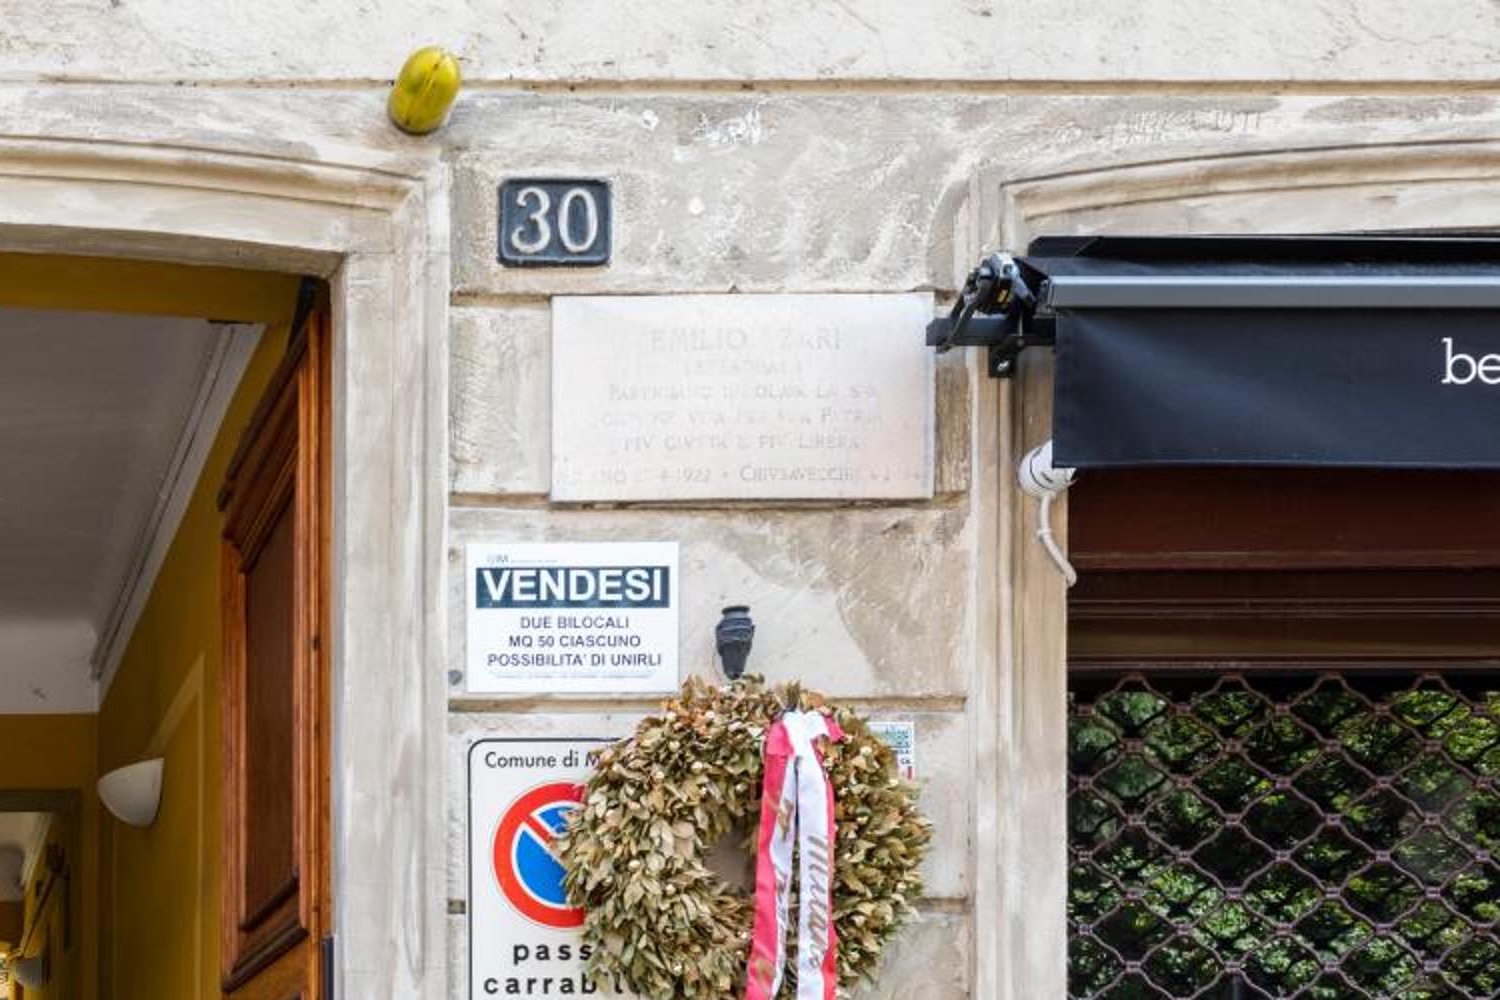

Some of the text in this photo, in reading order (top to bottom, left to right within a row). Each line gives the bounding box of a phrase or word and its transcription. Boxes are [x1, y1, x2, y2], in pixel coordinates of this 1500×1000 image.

[511, 186, 598, 253] 30
[483, 568, 661, 601] VENDESI
[520, 616, 629, 629] DUE BILOCALI
[537, 635, 555, 647] 50
[559, 635, 641, 647] CIASCUNO
[591, 653, 606, 666] DI
[611, 653, 662, 666] UNIRLI
[485, 751, 557, 768] Comune
[562, 749, 579, 767] di
[513, 943, 593, 965] pass
